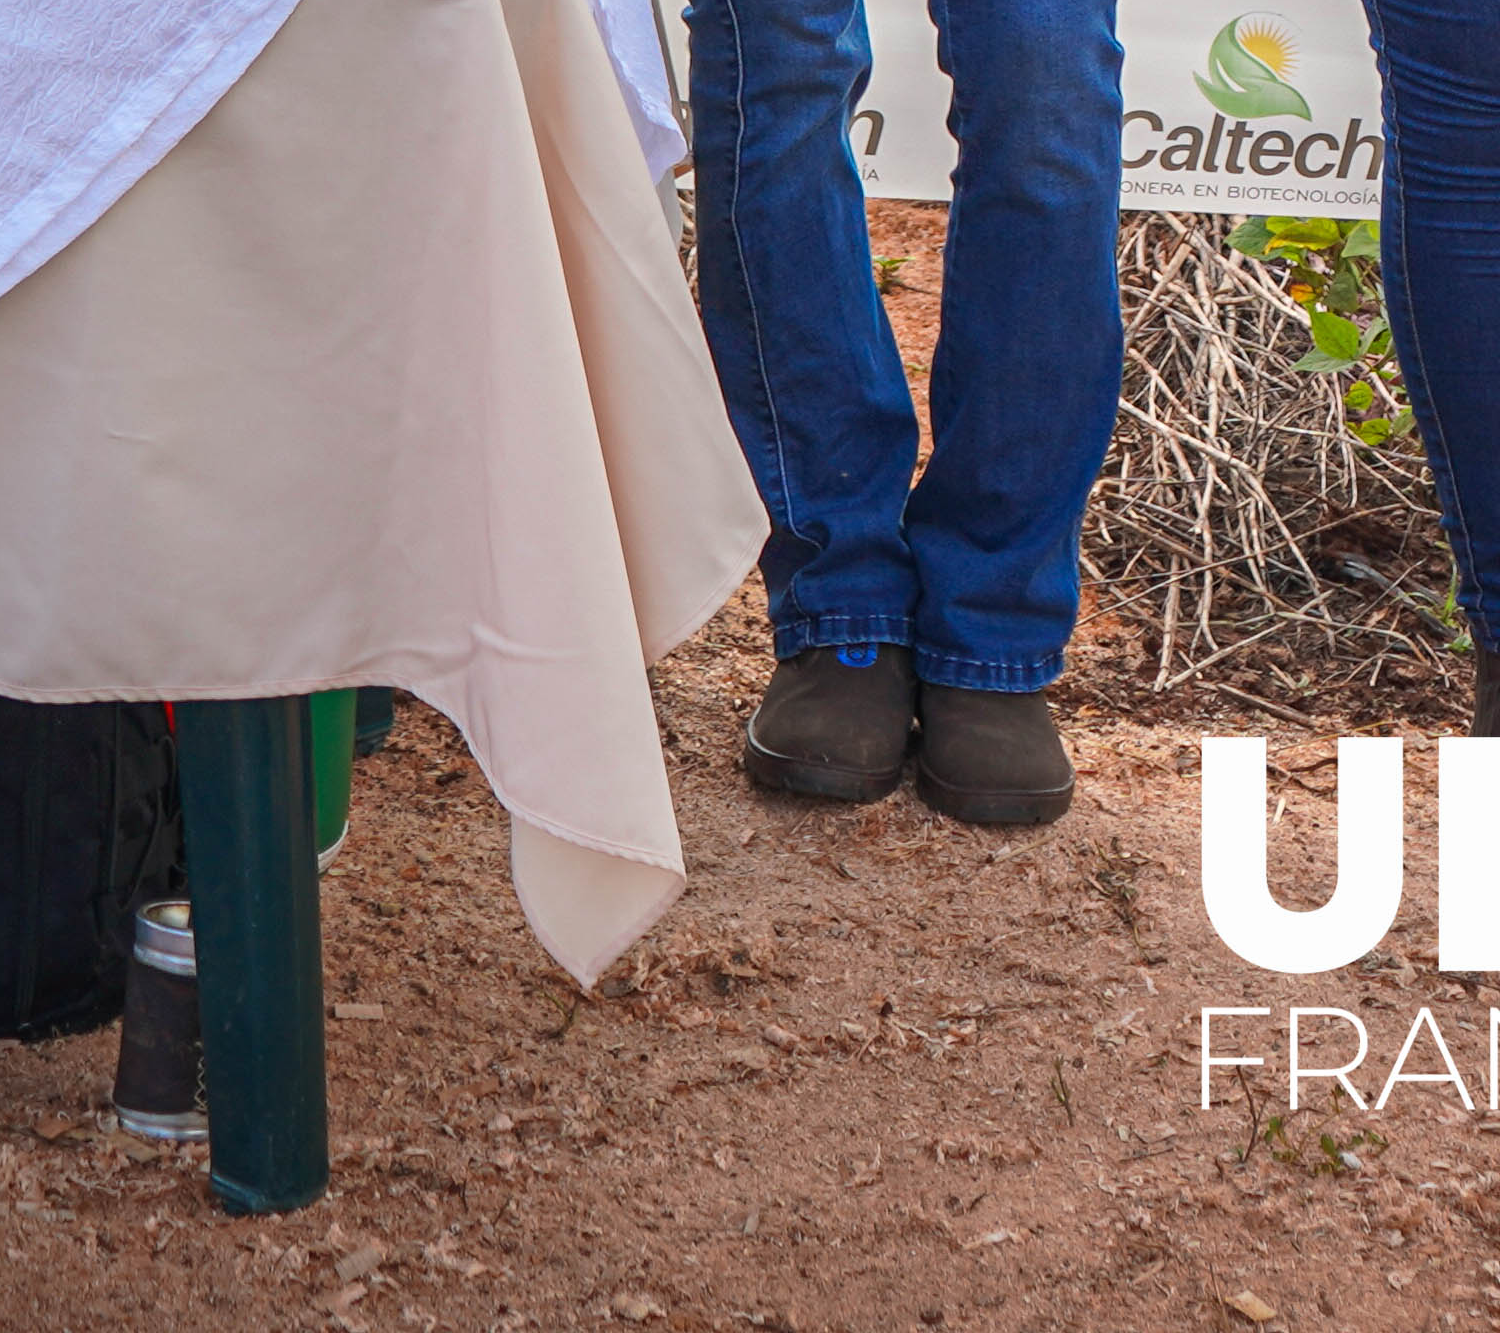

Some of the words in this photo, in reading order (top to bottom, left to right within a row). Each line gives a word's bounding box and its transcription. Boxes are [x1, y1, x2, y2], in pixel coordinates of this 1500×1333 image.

[1120, 109, 1386, 181] Caltech
[1193, 183, 1219, 197] EN
[1227, 186, 1381, 205] BIOTECNOLOGÍA
